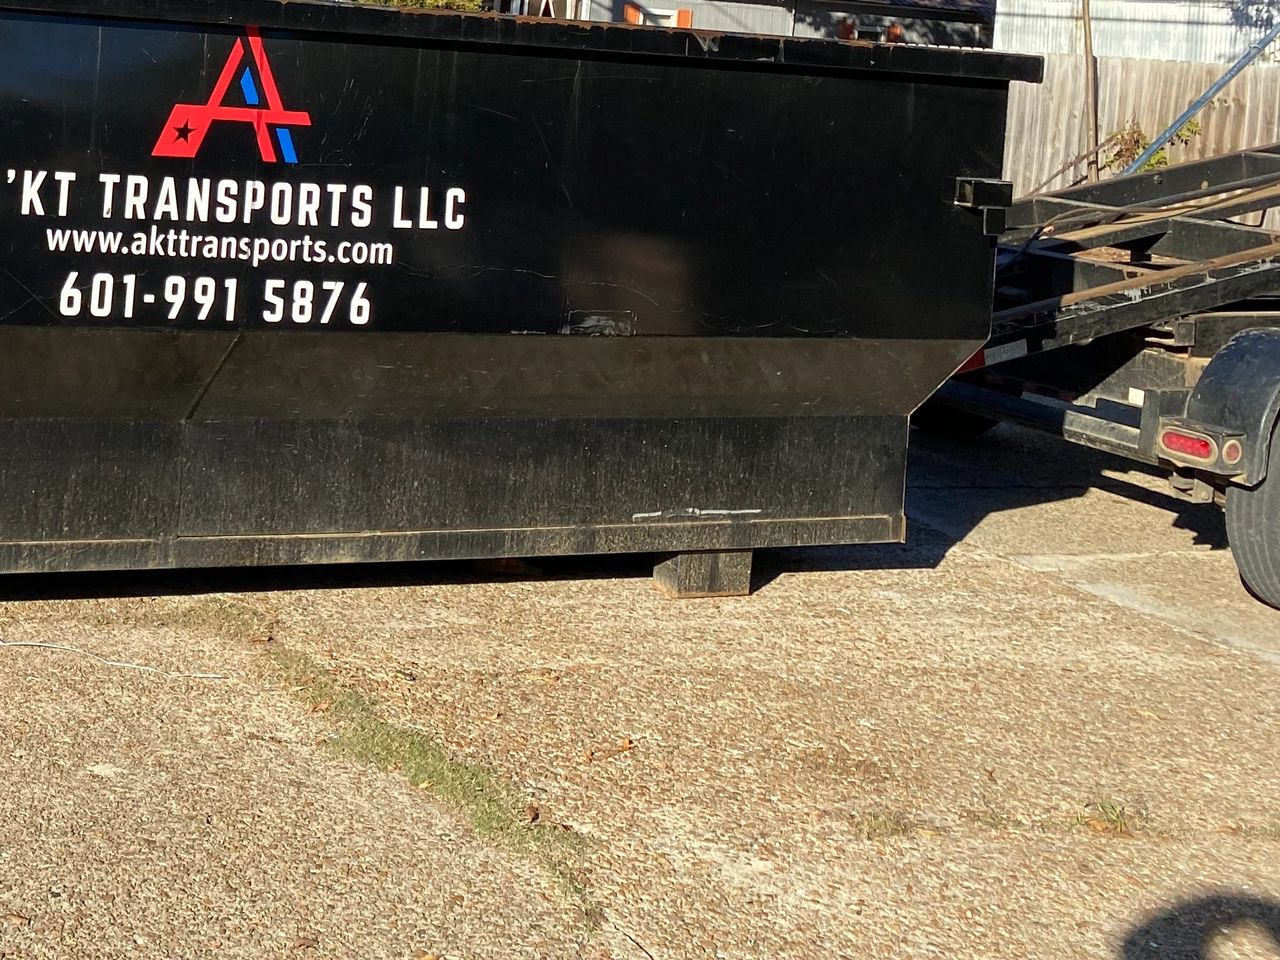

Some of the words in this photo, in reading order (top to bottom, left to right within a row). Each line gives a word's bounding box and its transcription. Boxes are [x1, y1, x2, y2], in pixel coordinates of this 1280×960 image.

[98, 173, 373, 228] TRANSPORTS
[392, 185, 466, 230] LLC
[46, 225, 393, 267] www.akttransports.com
[59, 271, 238, 322] 601-991
[262, 279, 371, 325] 5876
